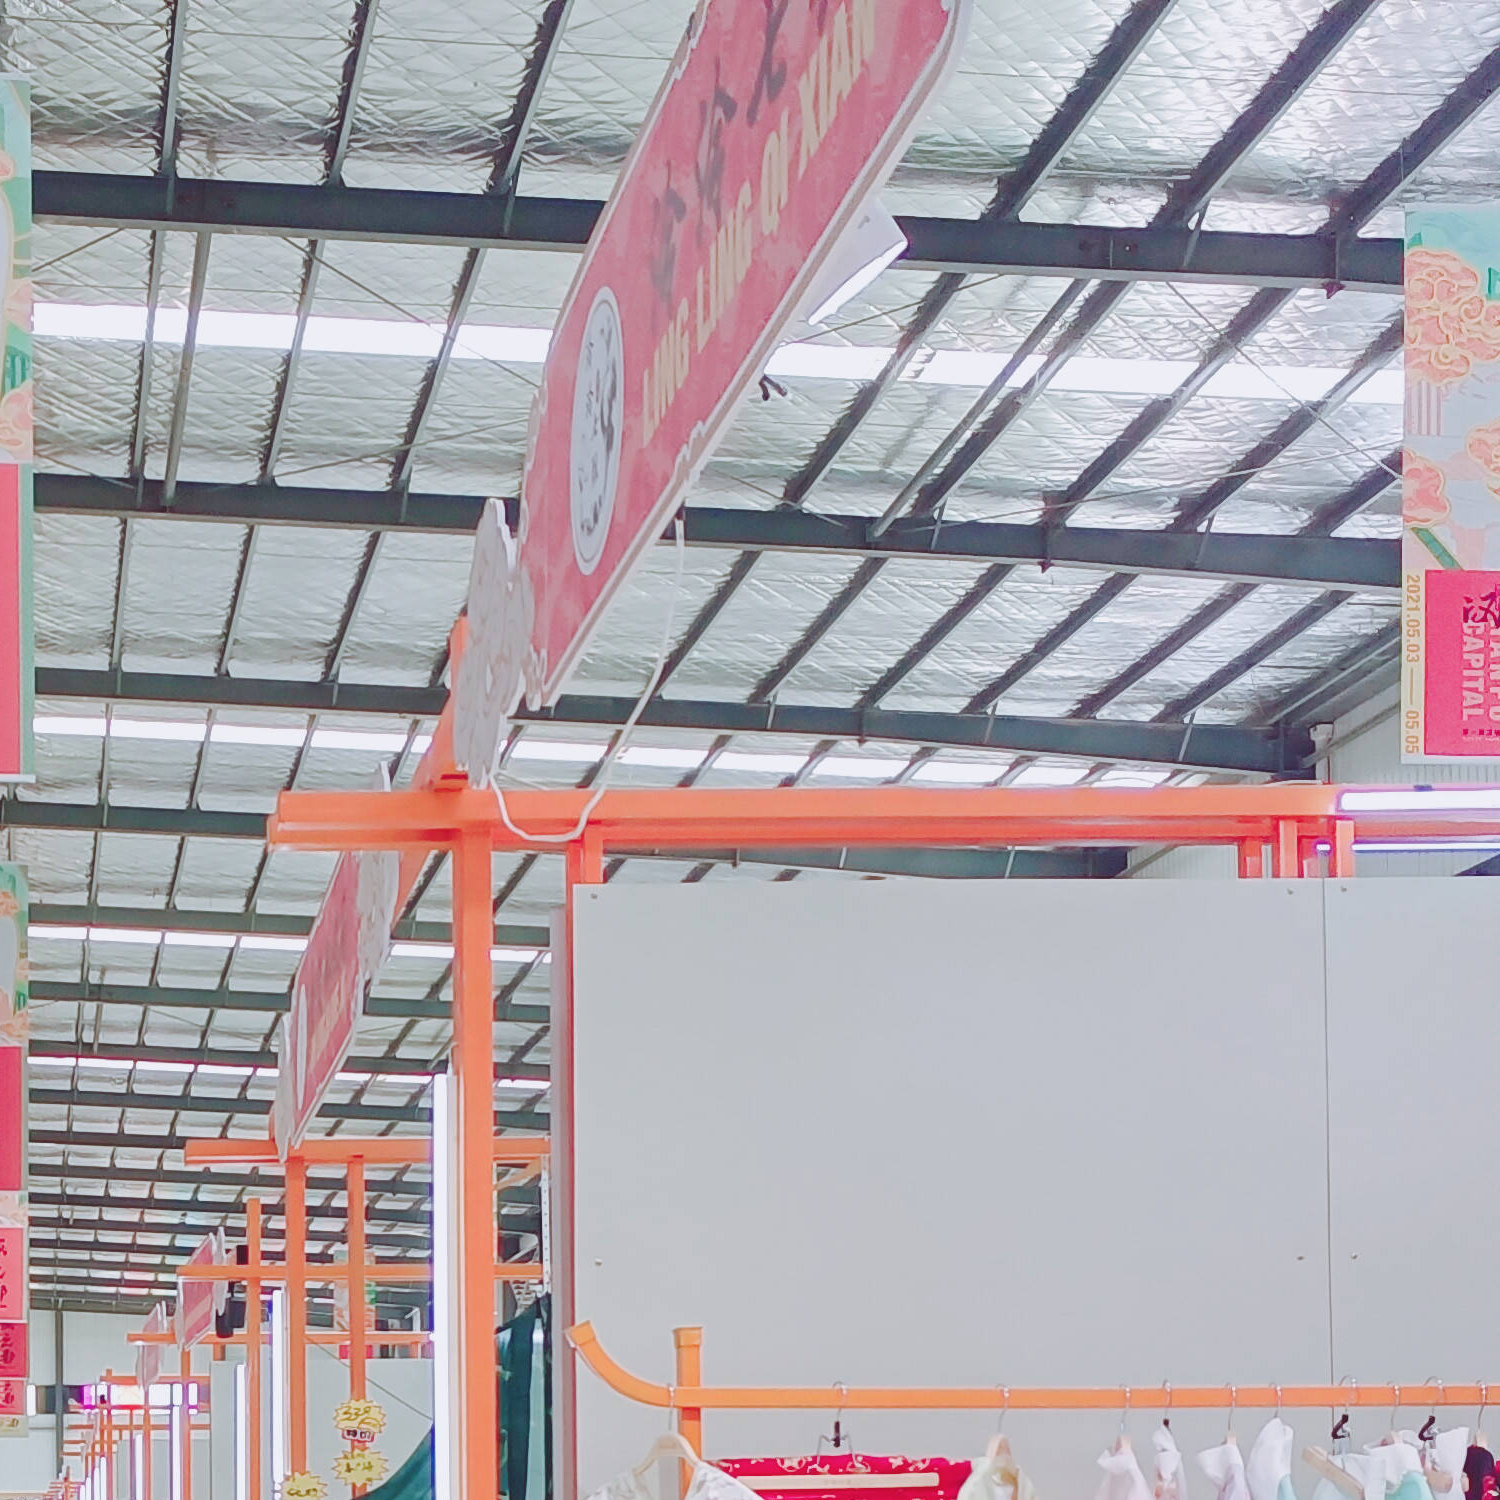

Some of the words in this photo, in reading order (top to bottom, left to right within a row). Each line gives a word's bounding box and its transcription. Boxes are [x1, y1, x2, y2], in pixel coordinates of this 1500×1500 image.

[643, 296, 690, 449] LING
[696, 177, 753, 355] LING
[760, 105, 789, 237] QI
[1406, 574, 1421, 664] 2021.05.03
[1462, 619, 1485, 722] CAPITAL
[1404, 710, 1420, 755] 05.05
